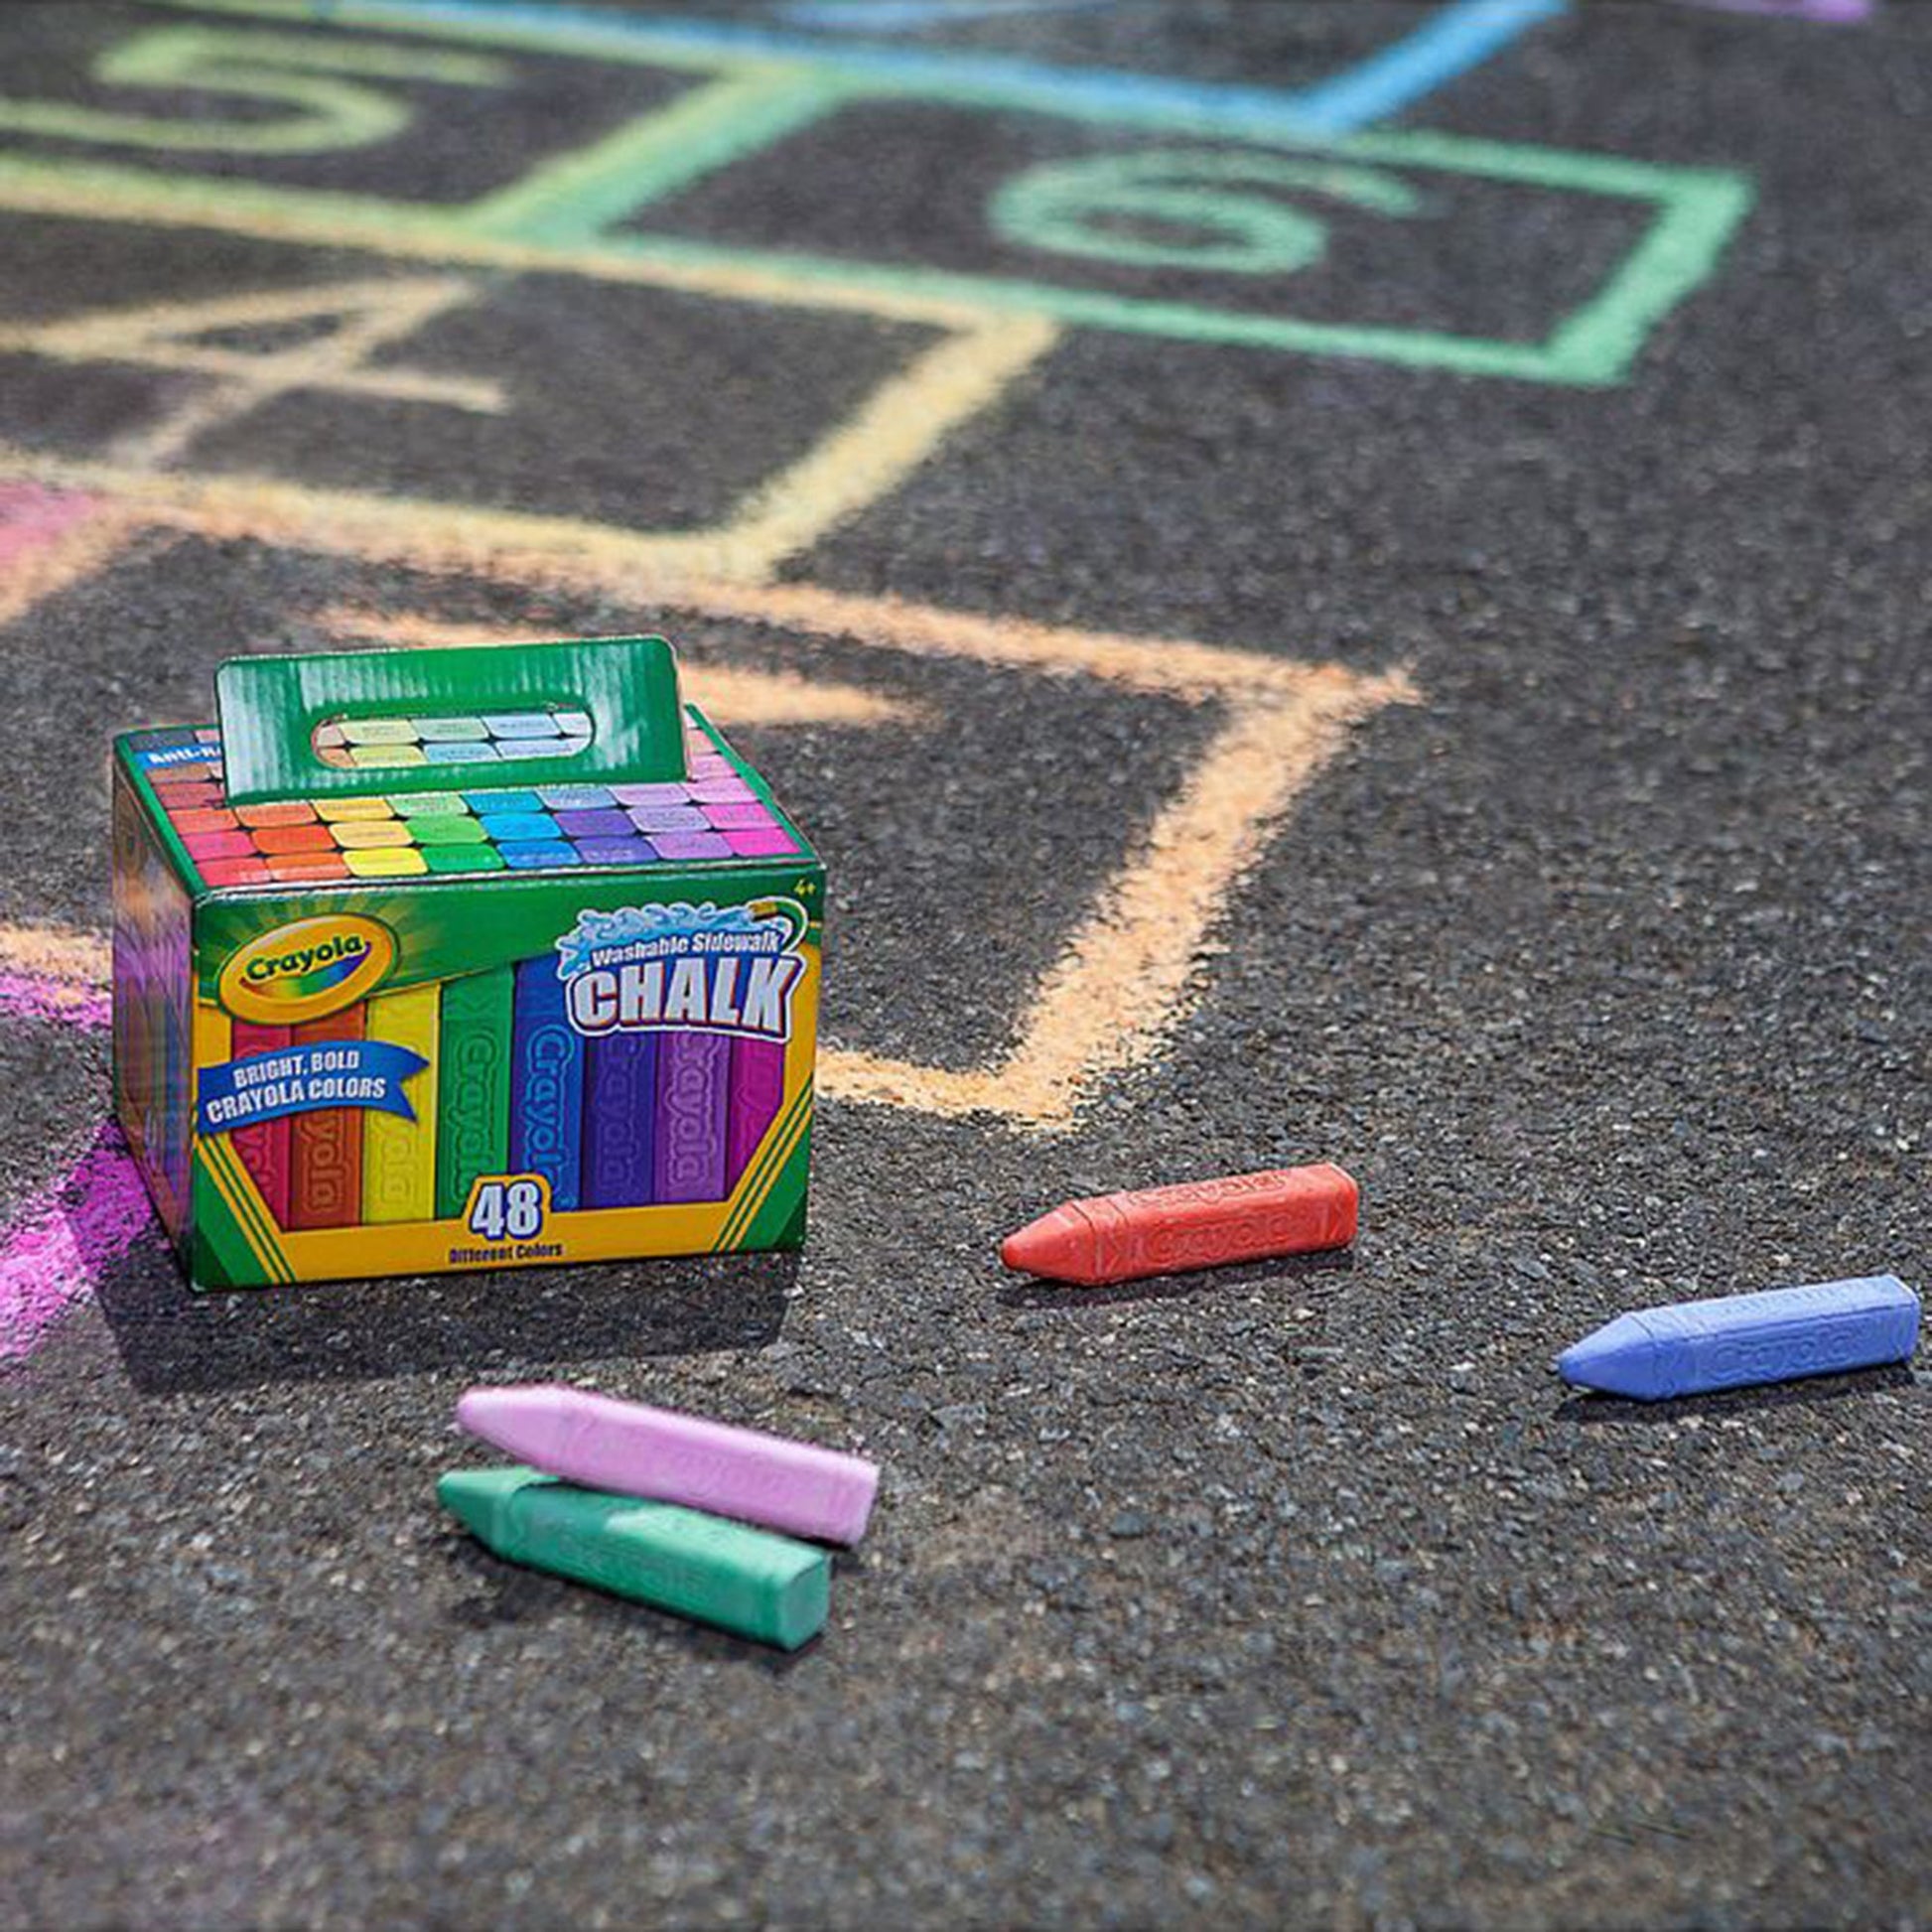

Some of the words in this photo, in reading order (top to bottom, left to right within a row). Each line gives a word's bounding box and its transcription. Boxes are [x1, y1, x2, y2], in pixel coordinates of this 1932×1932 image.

[991, 149, 1427, 275] 6
[0, 274, 510, 475] 4
[793, 878, 816, 896] 4+
[246, 935, 363, 981] Crayola
[592, 938, 688, 967] Washable
[691, 930, 779, 953] Sidewalk
[573, 956, 799, 1034] CHALK
[310, 1050, 360, 1072] BOLD
[206, 1079, 306, 1124] CRAYOLA
[308, 1077, 387, 1100] COLORS
[471, 1181, 541, 1238] 48
[450, 1246, 513, 1264] Different
[516, 1243, 564, 1259] Colors
